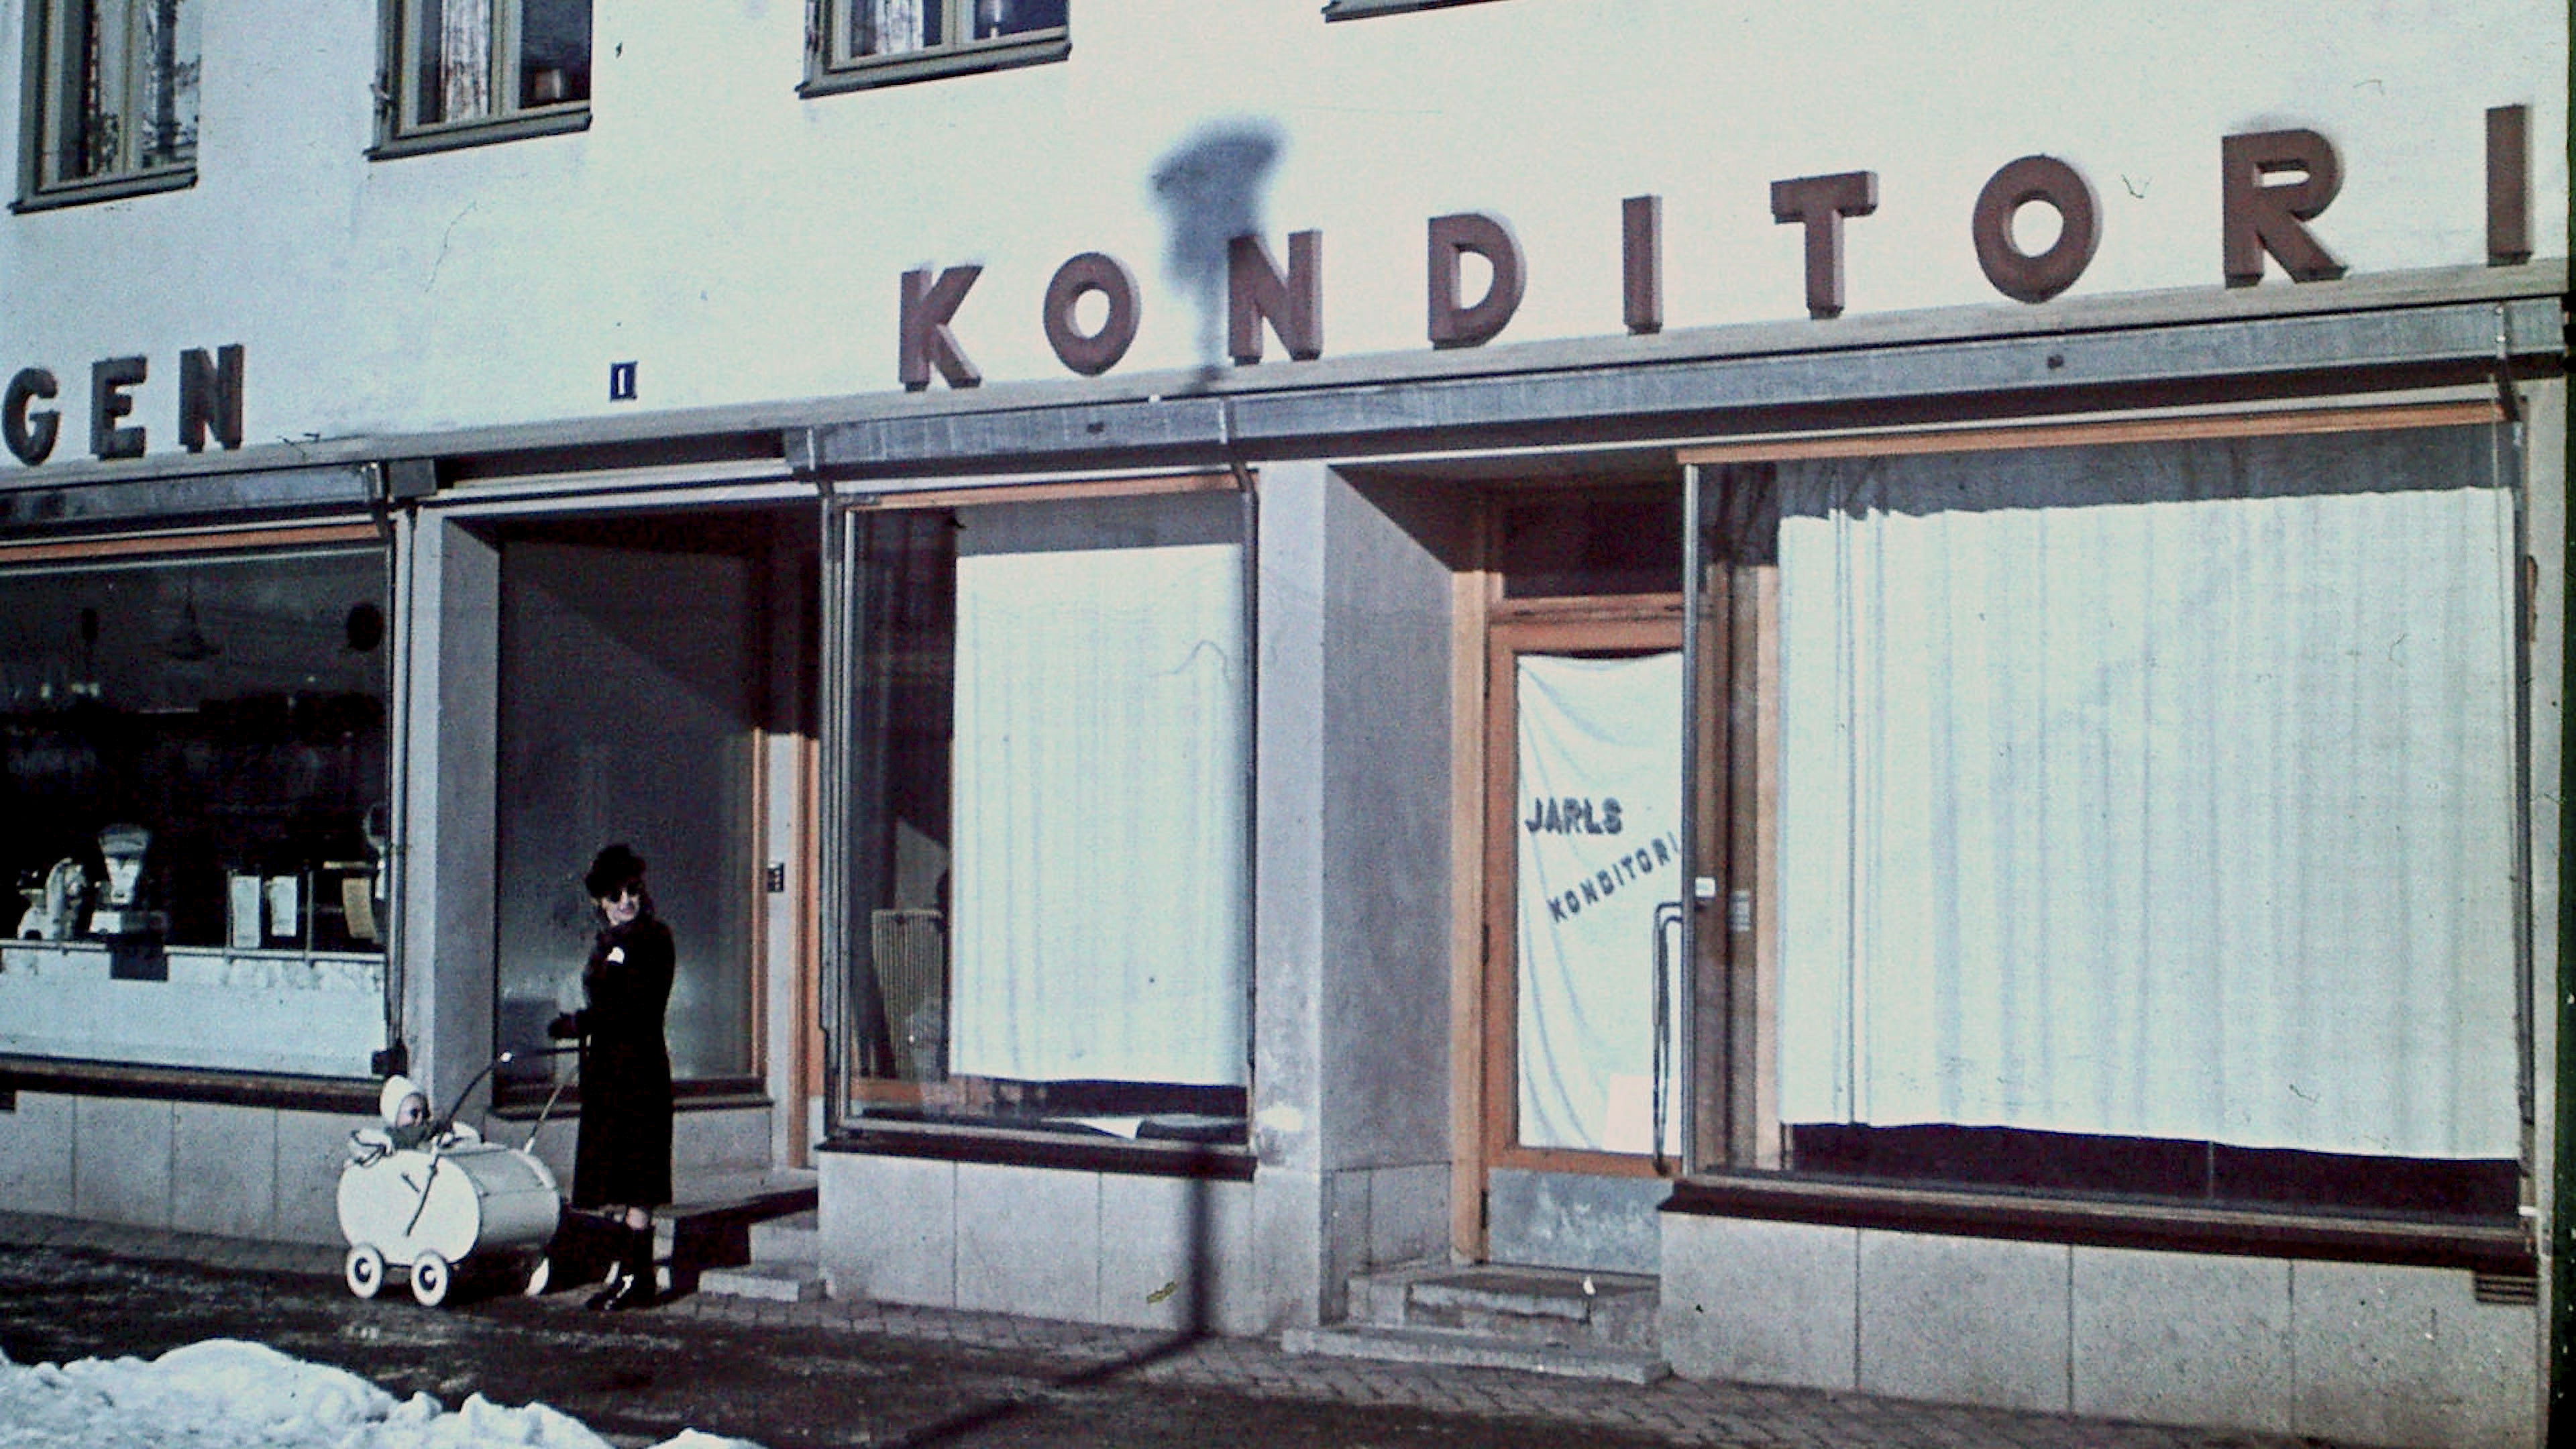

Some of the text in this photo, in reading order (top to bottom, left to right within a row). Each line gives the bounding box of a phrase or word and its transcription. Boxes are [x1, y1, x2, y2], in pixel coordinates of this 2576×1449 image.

[899, 104, 2534, 391] KONDITORI
[2, 343, 245, 467] GEN
[1524, 796, 1623, 835] JARLS
[1546, 830, 1678, 923] KONDITORI
